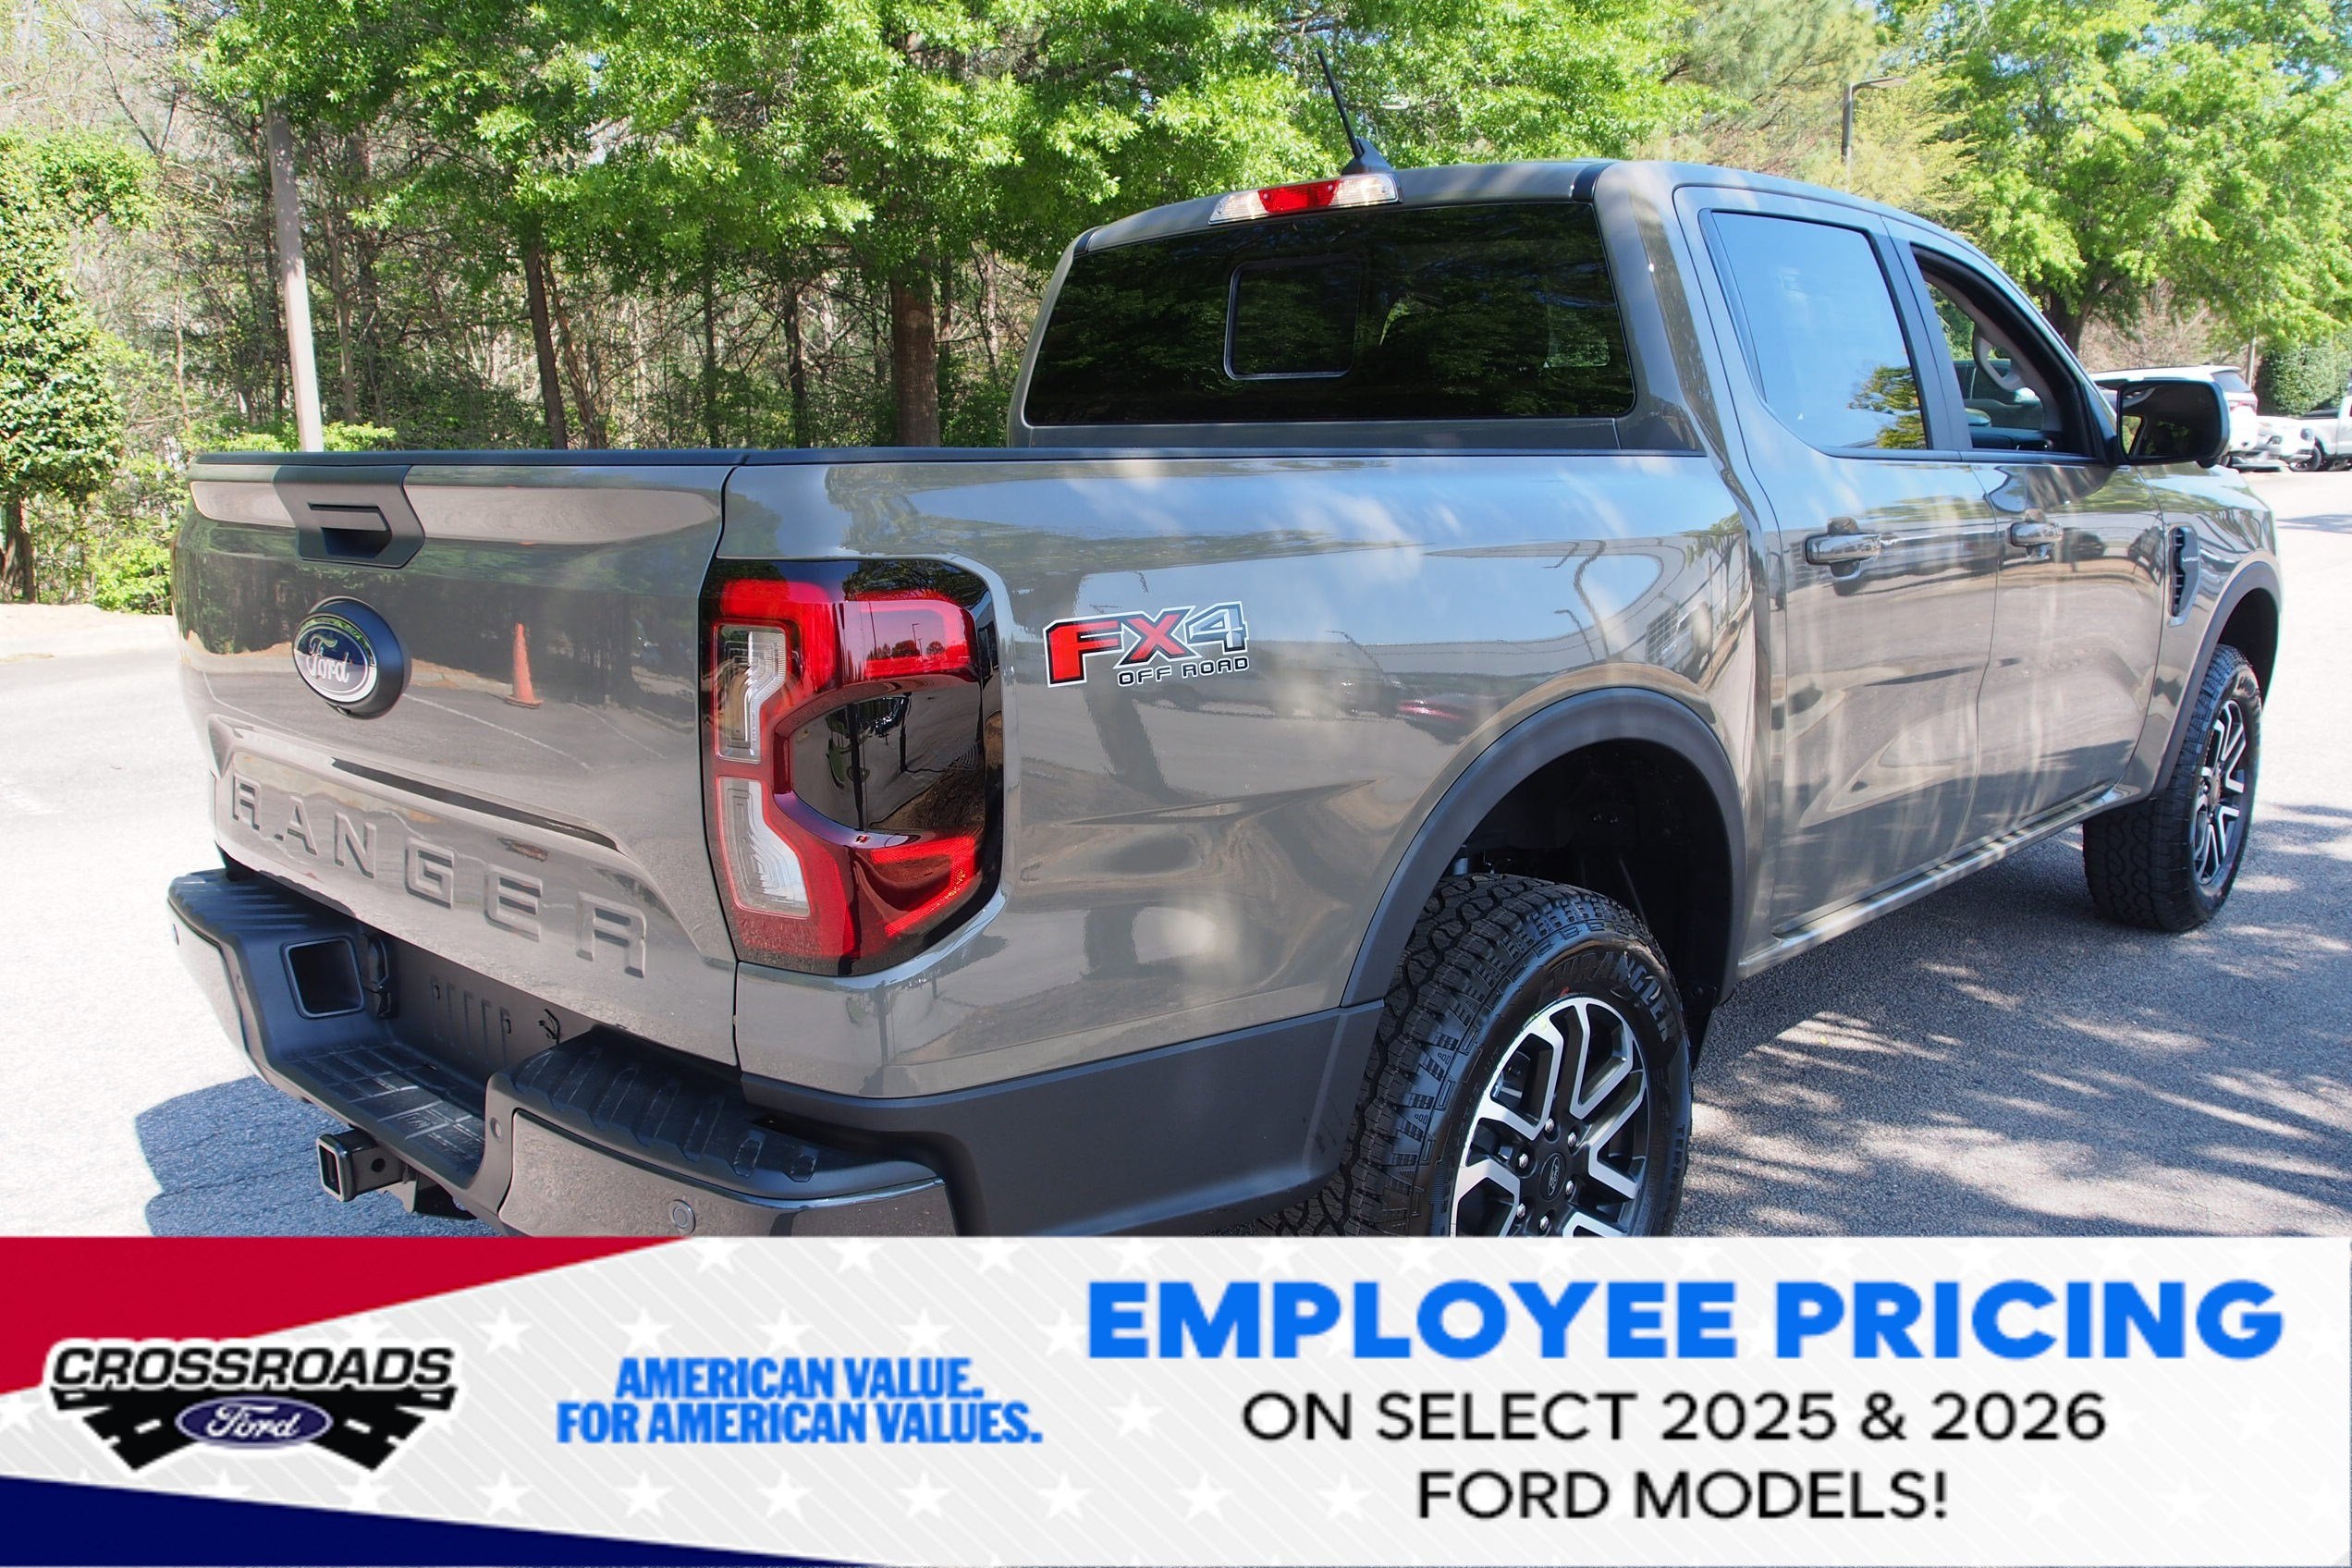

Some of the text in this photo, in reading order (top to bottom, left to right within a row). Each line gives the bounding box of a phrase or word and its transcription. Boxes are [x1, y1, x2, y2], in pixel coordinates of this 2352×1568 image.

[305, 633, 350, 683] Ford
[1043, 601, 1249, 688] FX4
[1118, 656, 1249, 687] OFF ROAD
[231, 773, 647, 979] RANGER
